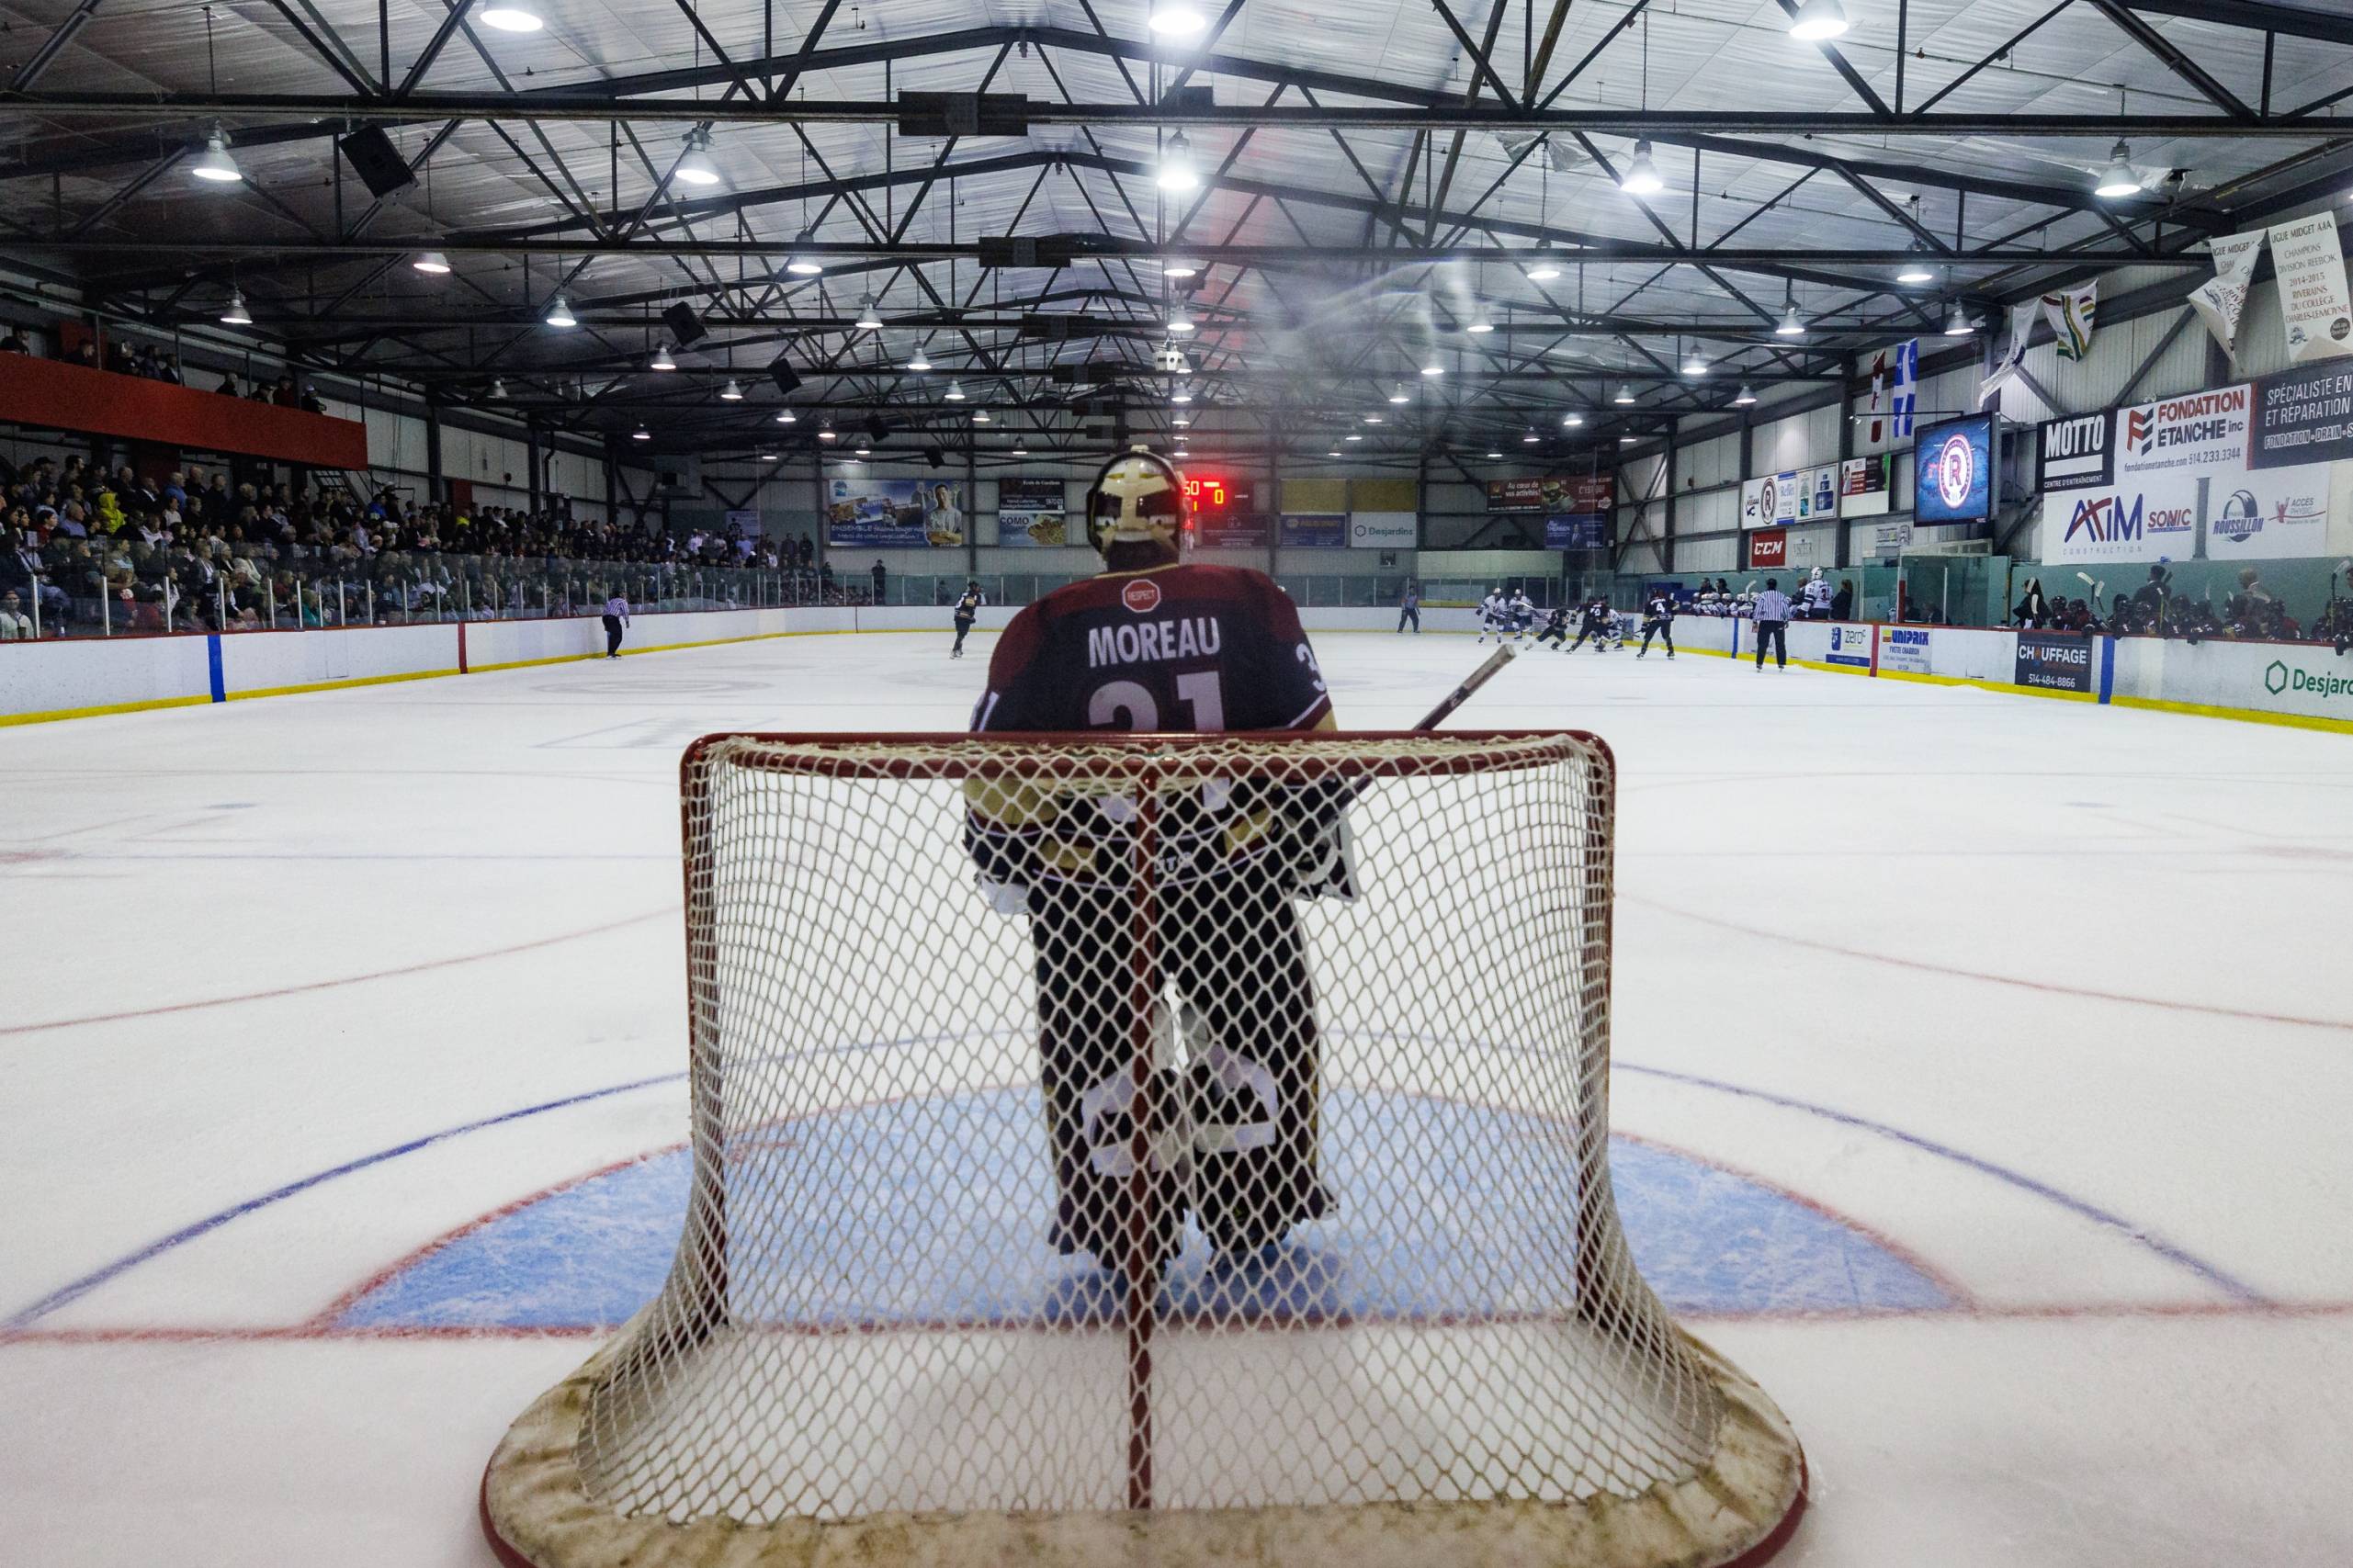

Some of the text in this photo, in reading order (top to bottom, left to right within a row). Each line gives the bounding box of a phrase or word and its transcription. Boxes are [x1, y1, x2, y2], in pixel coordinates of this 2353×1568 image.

[2291, 224, 2314, 238] MIDGET
[2317, 220, 2333, 231] AAA
[2284, 243, 2322, 258] CHAMPIONS
[2279, 254, 2336, 274] DIVISION REEBOK
[2292, 285, 2328, 299] RIVERAINS
[2267, 374, 2352, 406] SPÉCIALISTE EN
[2158, 389, 2245, 423] FONDATION
[2265, 397, 2351, 427] ET RÉPARATION
[2045, 414, 2105, 458] MOTTO
[2264, 429, 2311, 449] FONDATION
[2315, 424, 2342, 442] DRAIN
[2189, 447, 2241, 465] 514.233.3344
[2043, 479, 2062, 489] CENTRE
[1215, 489, 1224, 504] 0
[1000, 516, 1029, 525] COMO
[2147, 508, 2192, 528] SONIC
[2213, 517, 2264, 535] ROUSSILLON
[1369, 527, 1413, 537] Desjardins
[1754, 541, 1782, 556] CCM
[2063, 546, 2143, 556] CONSTRUCTION
[1656, 602, 1665, 614] 4
[1089, 617, 1221, 669] MOREAU
[1892, 629, 1929, 646] UNIPRIX
[2029, 673, 2076, 687] 514-484-8866
